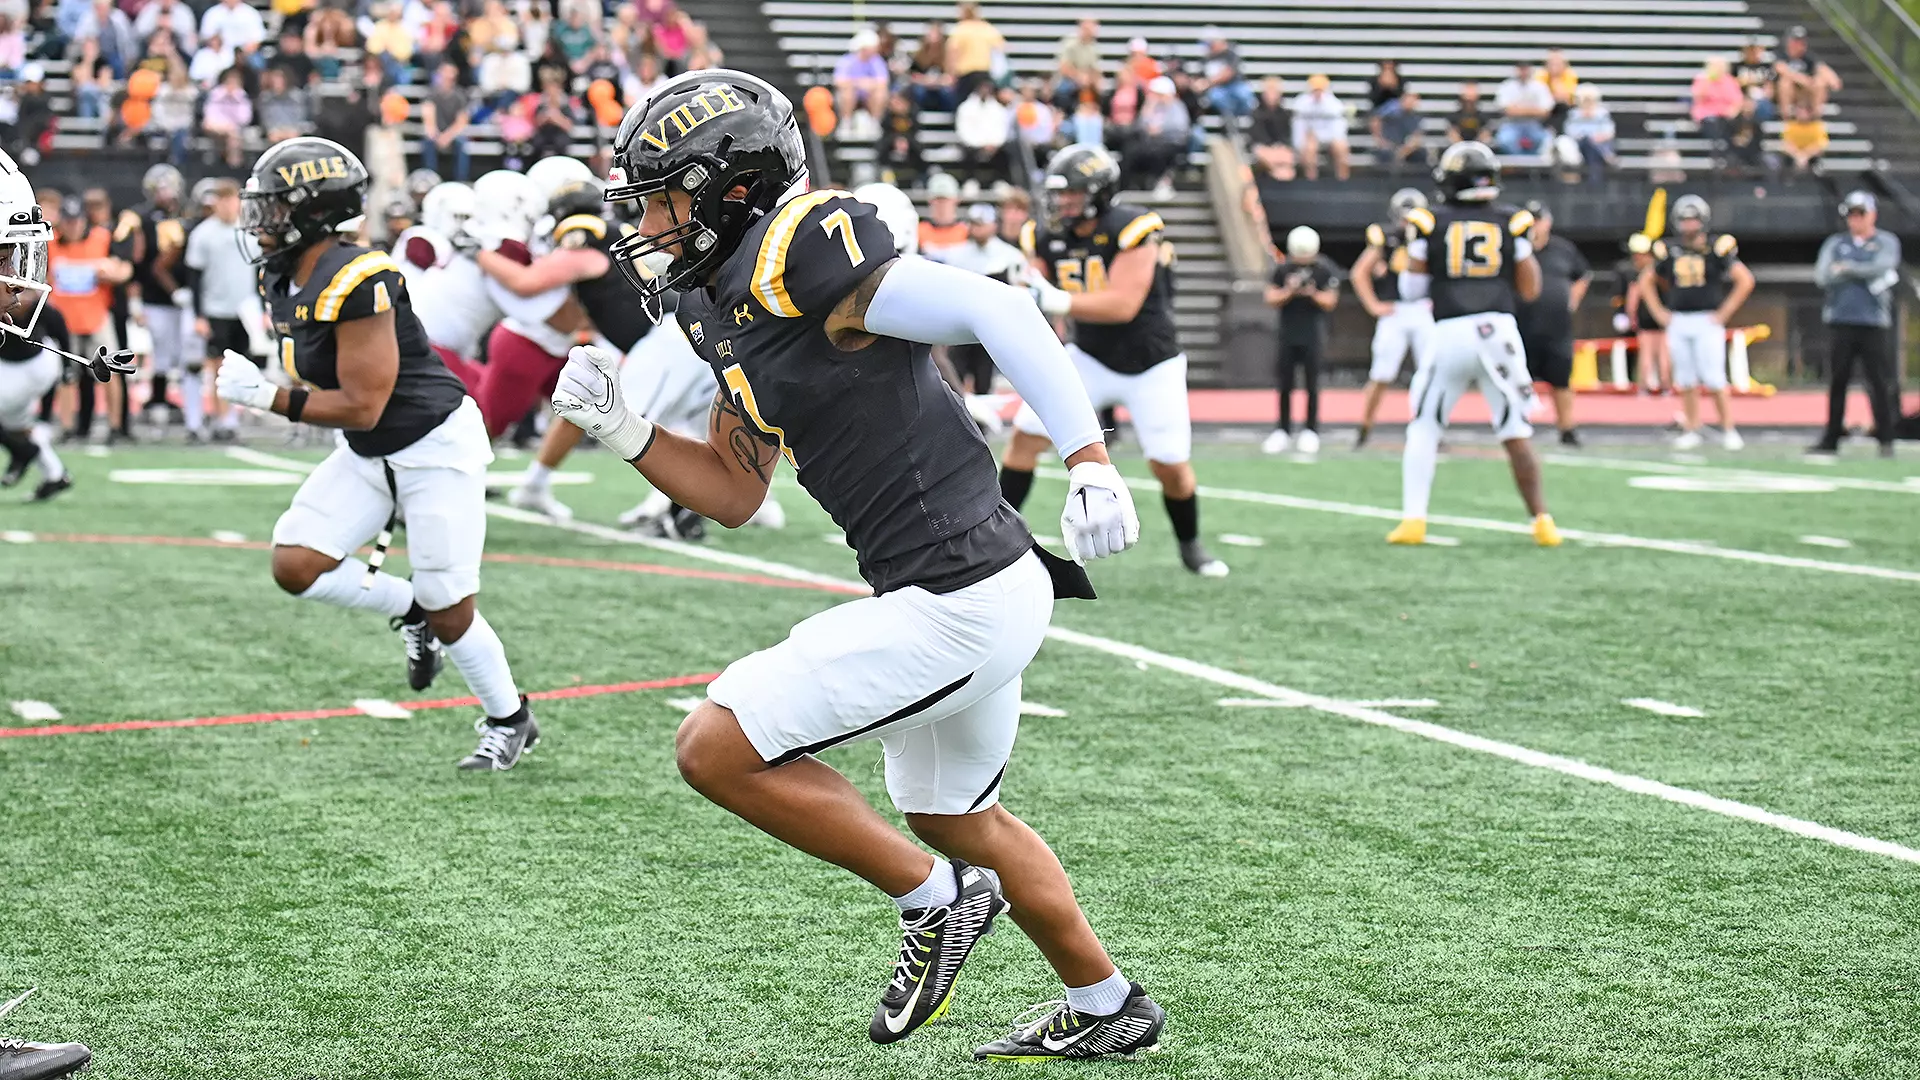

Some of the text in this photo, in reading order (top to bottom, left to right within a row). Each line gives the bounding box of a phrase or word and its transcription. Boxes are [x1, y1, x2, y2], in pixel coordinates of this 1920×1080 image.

[638, 82, 746, 152] VILLE
[277, 155, 348, 187] VILLE
[819, 207, 866, 268] 7
[1444, 219, 1502, 278] 13
[1056, 255, 1109, 292] 54
